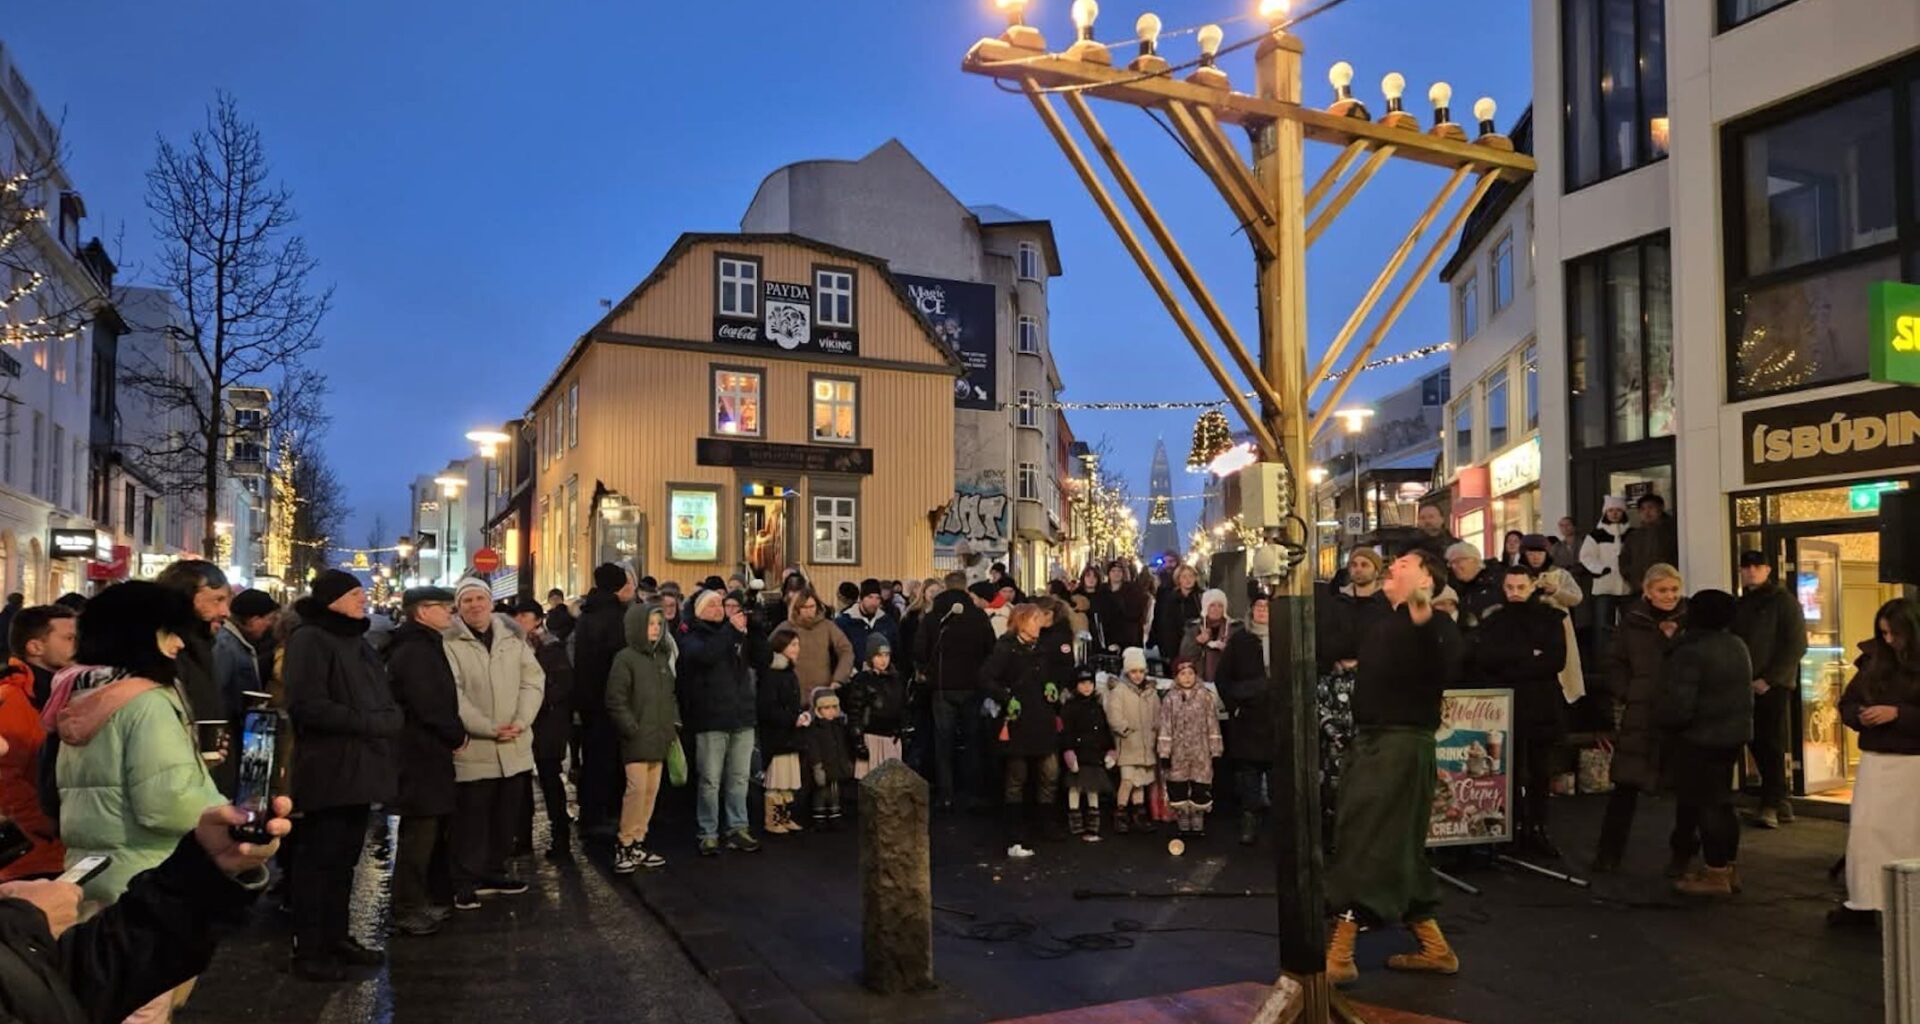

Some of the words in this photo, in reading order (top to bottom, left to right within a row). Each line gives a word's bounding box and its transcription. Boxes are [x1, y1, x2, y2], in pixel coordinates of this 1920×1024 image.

[766, 282, 810, 300] PAYDA
[908, 284, 945, 301] Magic
[1448, 700, 1504, 722] Waffles
[1455, 778, 1503, 811] Crepes
[1432, 822, 1468, 836] CREAM
